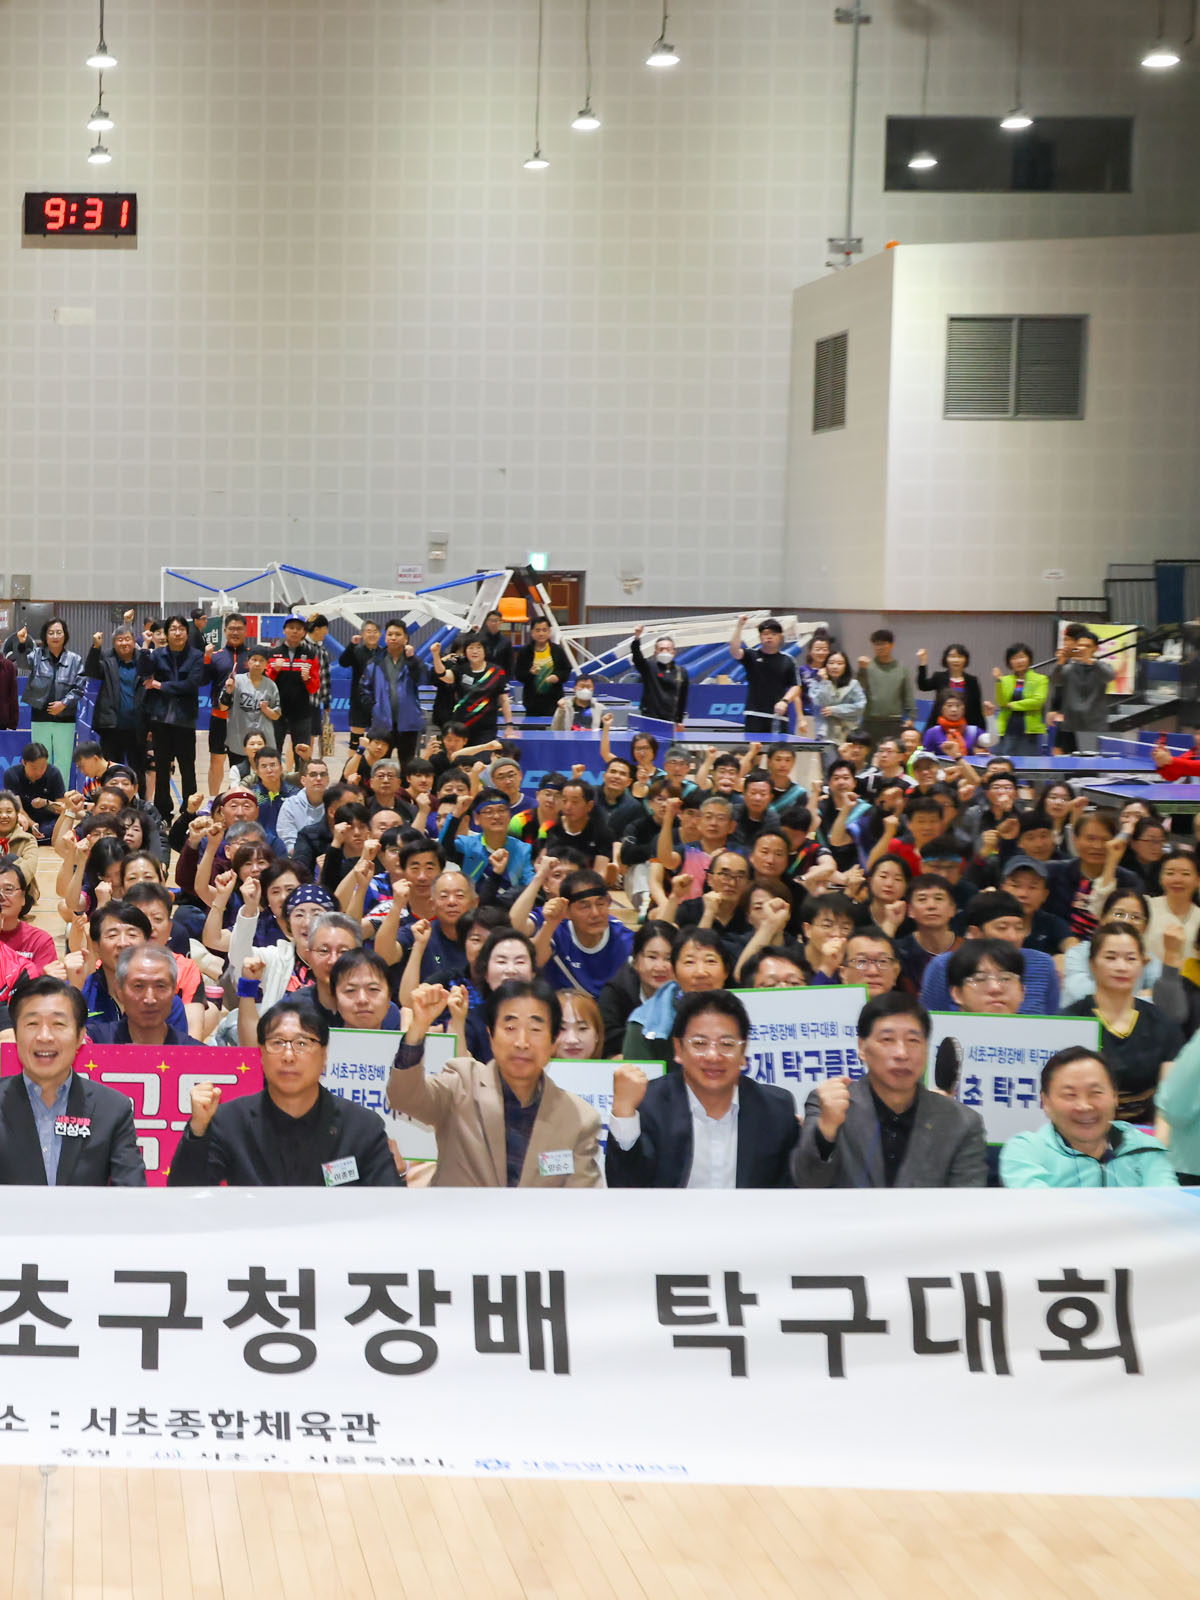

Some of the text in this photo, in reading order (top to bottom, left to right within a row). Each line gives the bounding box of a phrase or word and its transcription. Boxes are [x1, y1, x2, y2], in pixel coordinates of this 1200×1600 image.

[44, 197, 129, 230] 9:31
[749, 1022, 797, 1041] 초구청장배
[801, 1021, 838, 1040] 탁구대회
[968, 1046, 1025, 1064] 서초구청장배
[331, 1062, 385, 1081] 서초구청장배
[655, 1267, 1144, 1378] 탁구대회
[81, 1405, 382, 1444] 서초종합체육관
